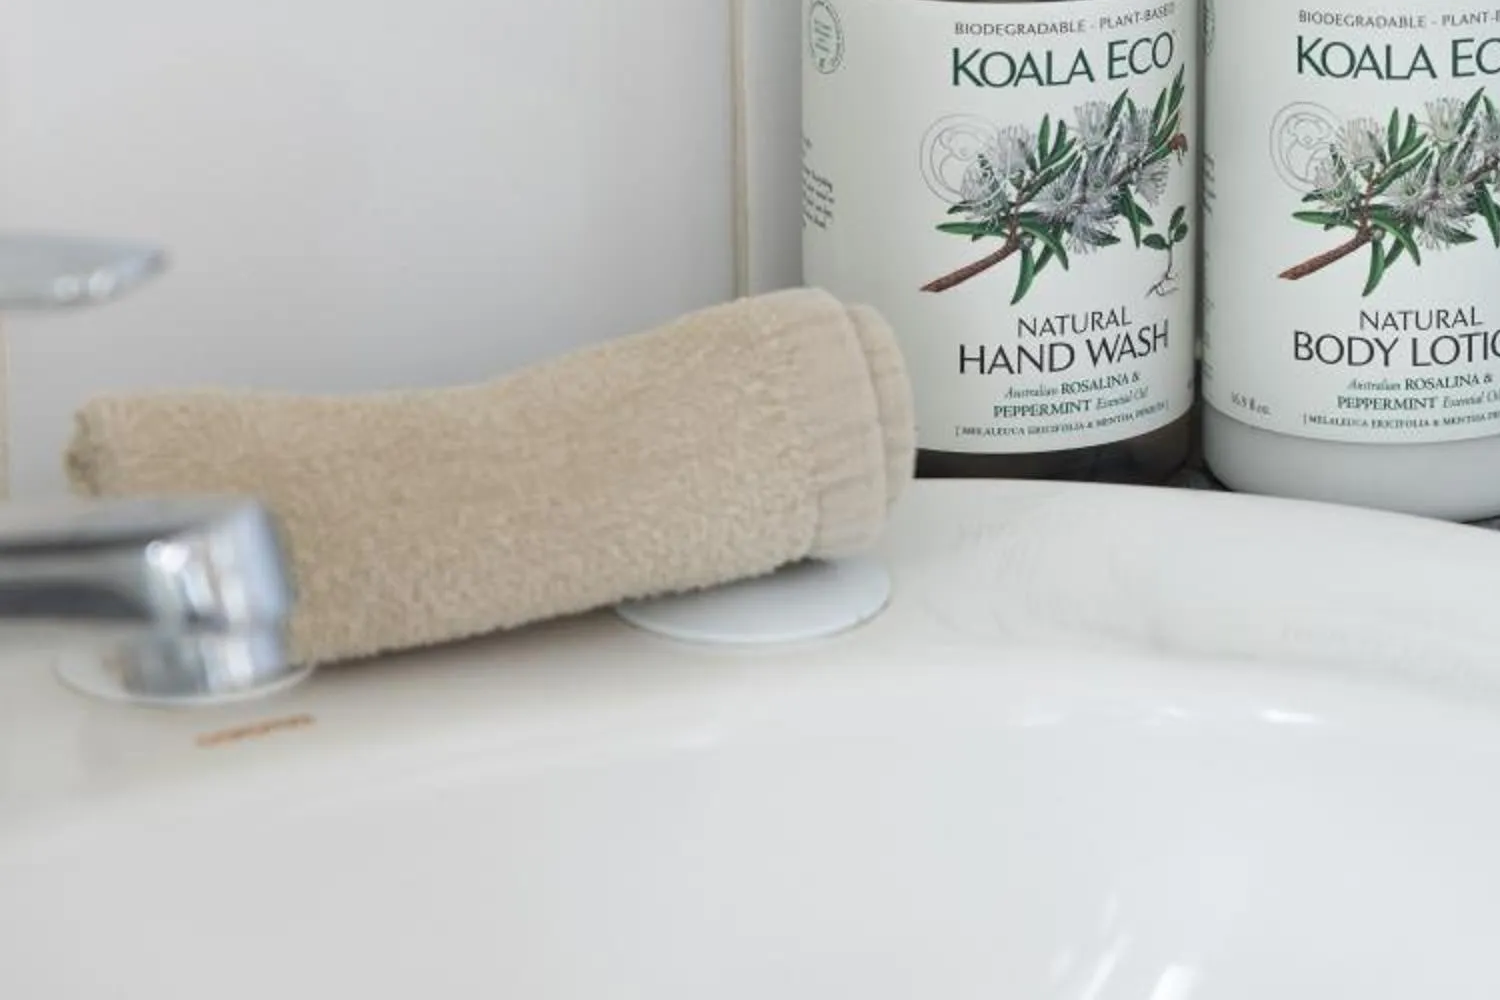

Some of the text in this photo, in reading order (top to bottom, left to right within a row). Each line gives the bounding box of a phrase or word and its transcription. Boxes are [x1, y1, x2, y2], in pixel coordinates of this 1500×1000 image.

[954, 18, 1085, 37] BIODEGRADABLE
[1298, 10, 1425, 29] BIODEGRADABLE
[951, 33, 1173, 88] KOALA ECO
[1296, 35, 1437, 80] KOALA
[1017, 305, 1132, 339] NATURAL
[1360, 306, 1484, 332] NATURAL
[958, 342, 1075, 375] HAND
[1085, 319, 1169, 367] WASH
[1293, 329, 1399, 367] BODY
[1004, 384, 1058, 400] Australian
[1061, 374, 1129, 395] ROSALINA
[1347, 373, 1493, 392] Australian ROSALINA &
[993, 400, 1091, 418] PEPPERMINT
[1337, 395, 1437, 411] PEPPERMINT
